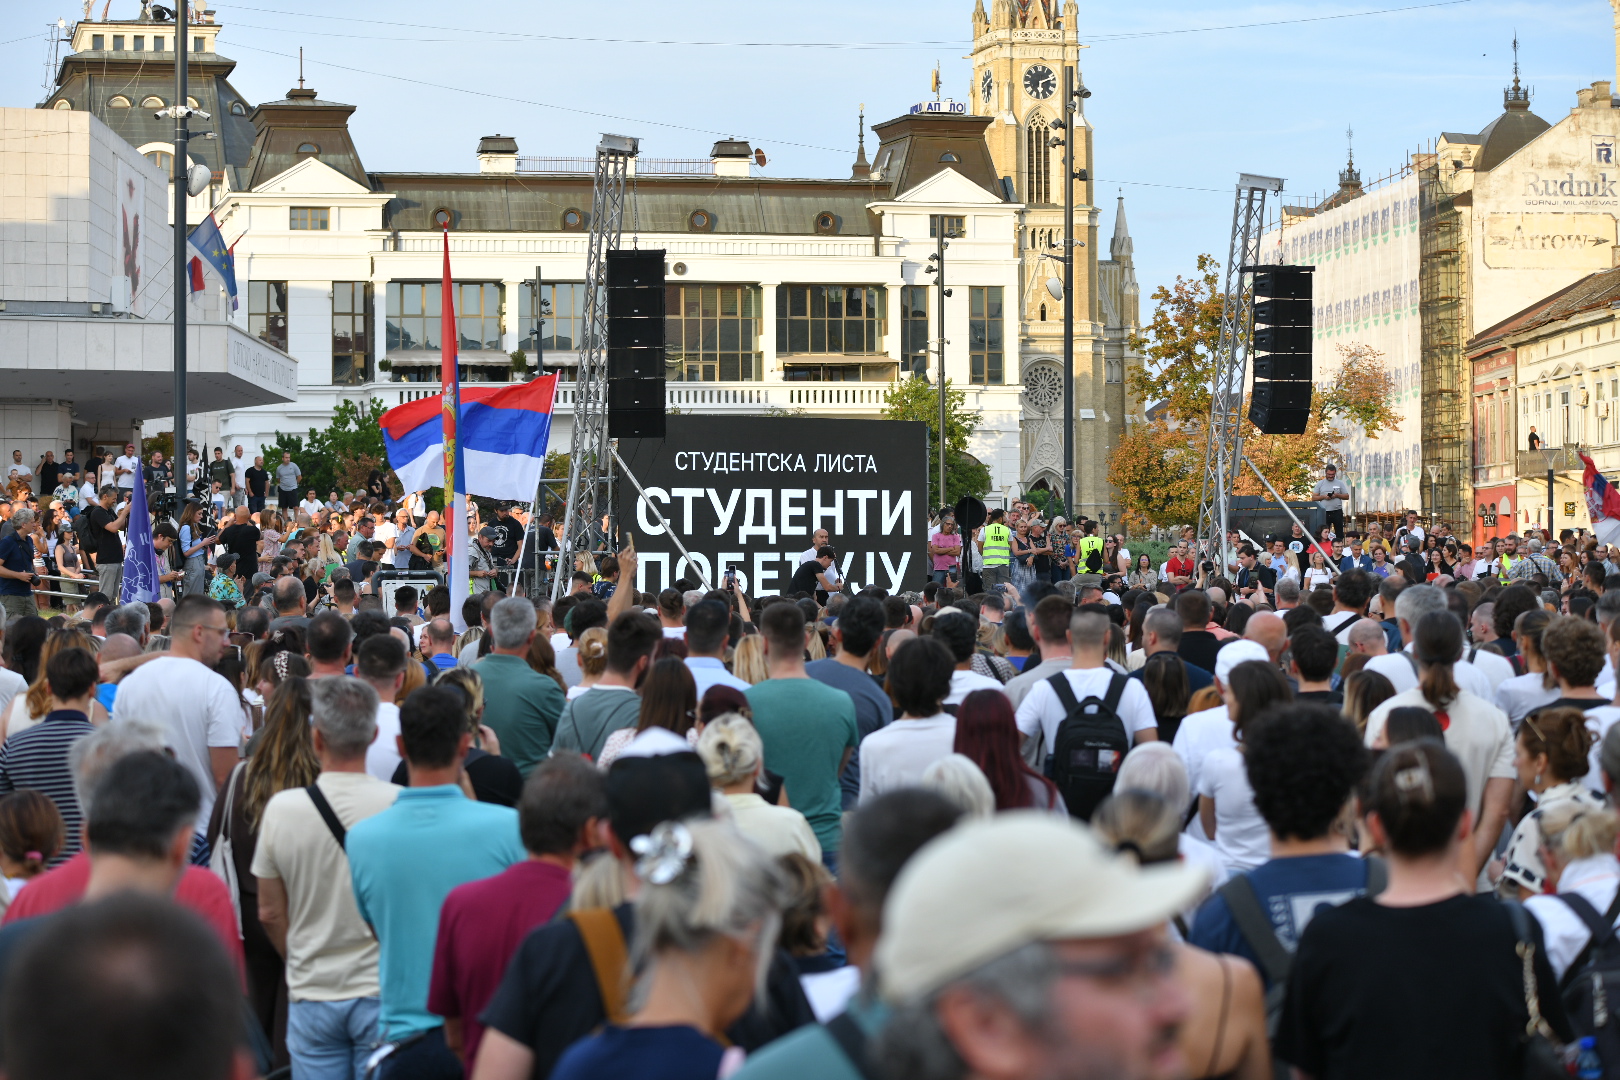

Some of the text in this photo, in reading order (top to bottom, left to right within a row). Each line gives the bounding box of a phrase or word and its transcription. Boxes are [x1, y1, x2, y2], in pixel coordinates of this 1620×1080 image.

[1521, 172, 1618, 197] Rudnik
[1508, 225, 1589, 250] Arrow
[674, 451, 877, 474] СТУДЕНТСКА ЛИСТА
[636, 487, 912, 544] СТУДЕНТИ
[1484, 515, 1495, 524] FLY
